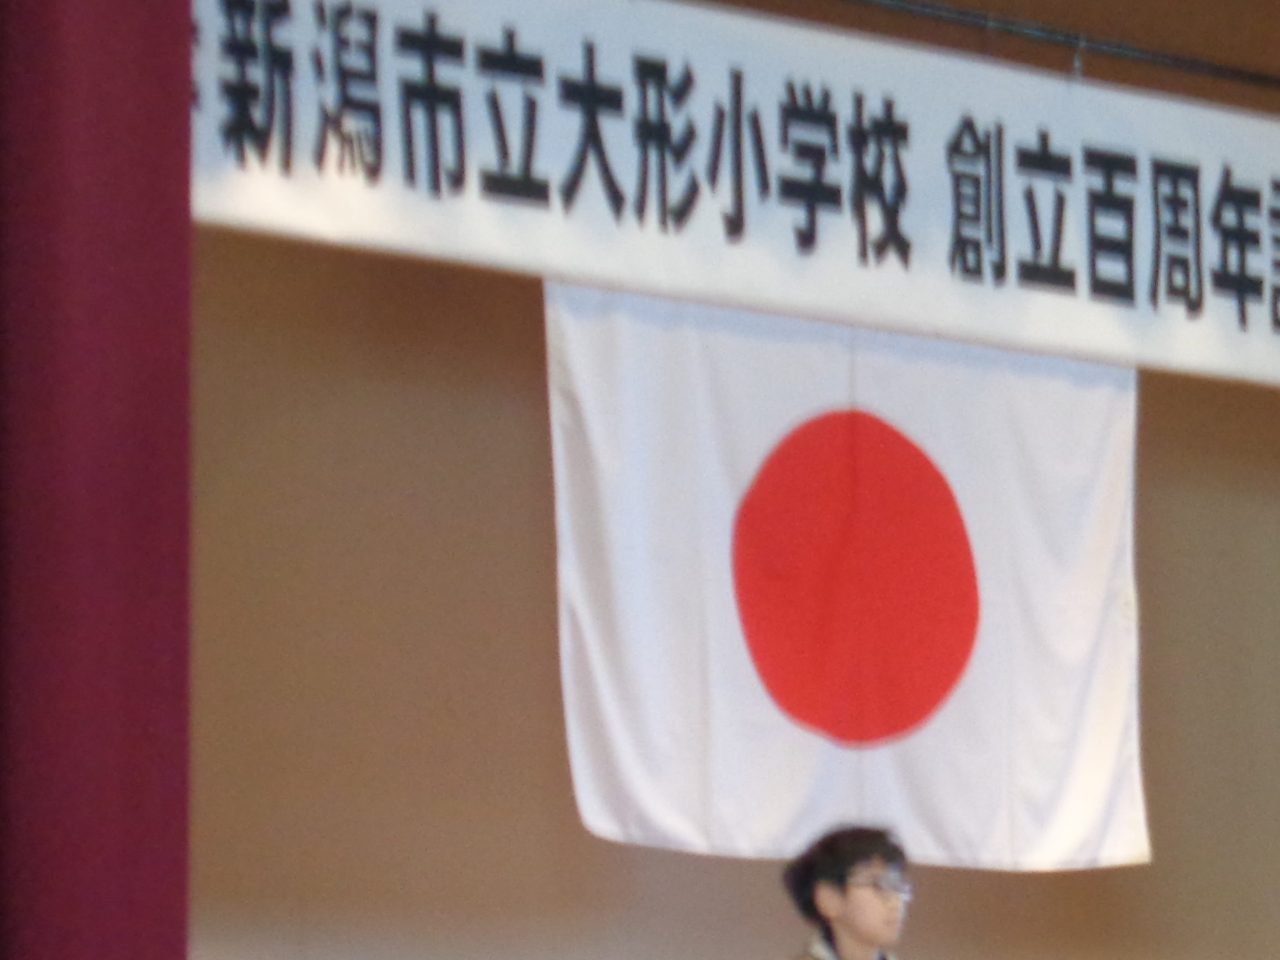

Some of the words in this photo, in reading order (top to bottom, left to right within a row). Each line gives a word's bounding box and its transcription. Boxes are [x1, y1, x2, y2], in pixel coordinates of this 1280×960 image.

[192, 0, 912, 268] 新潟市立大形小学校
